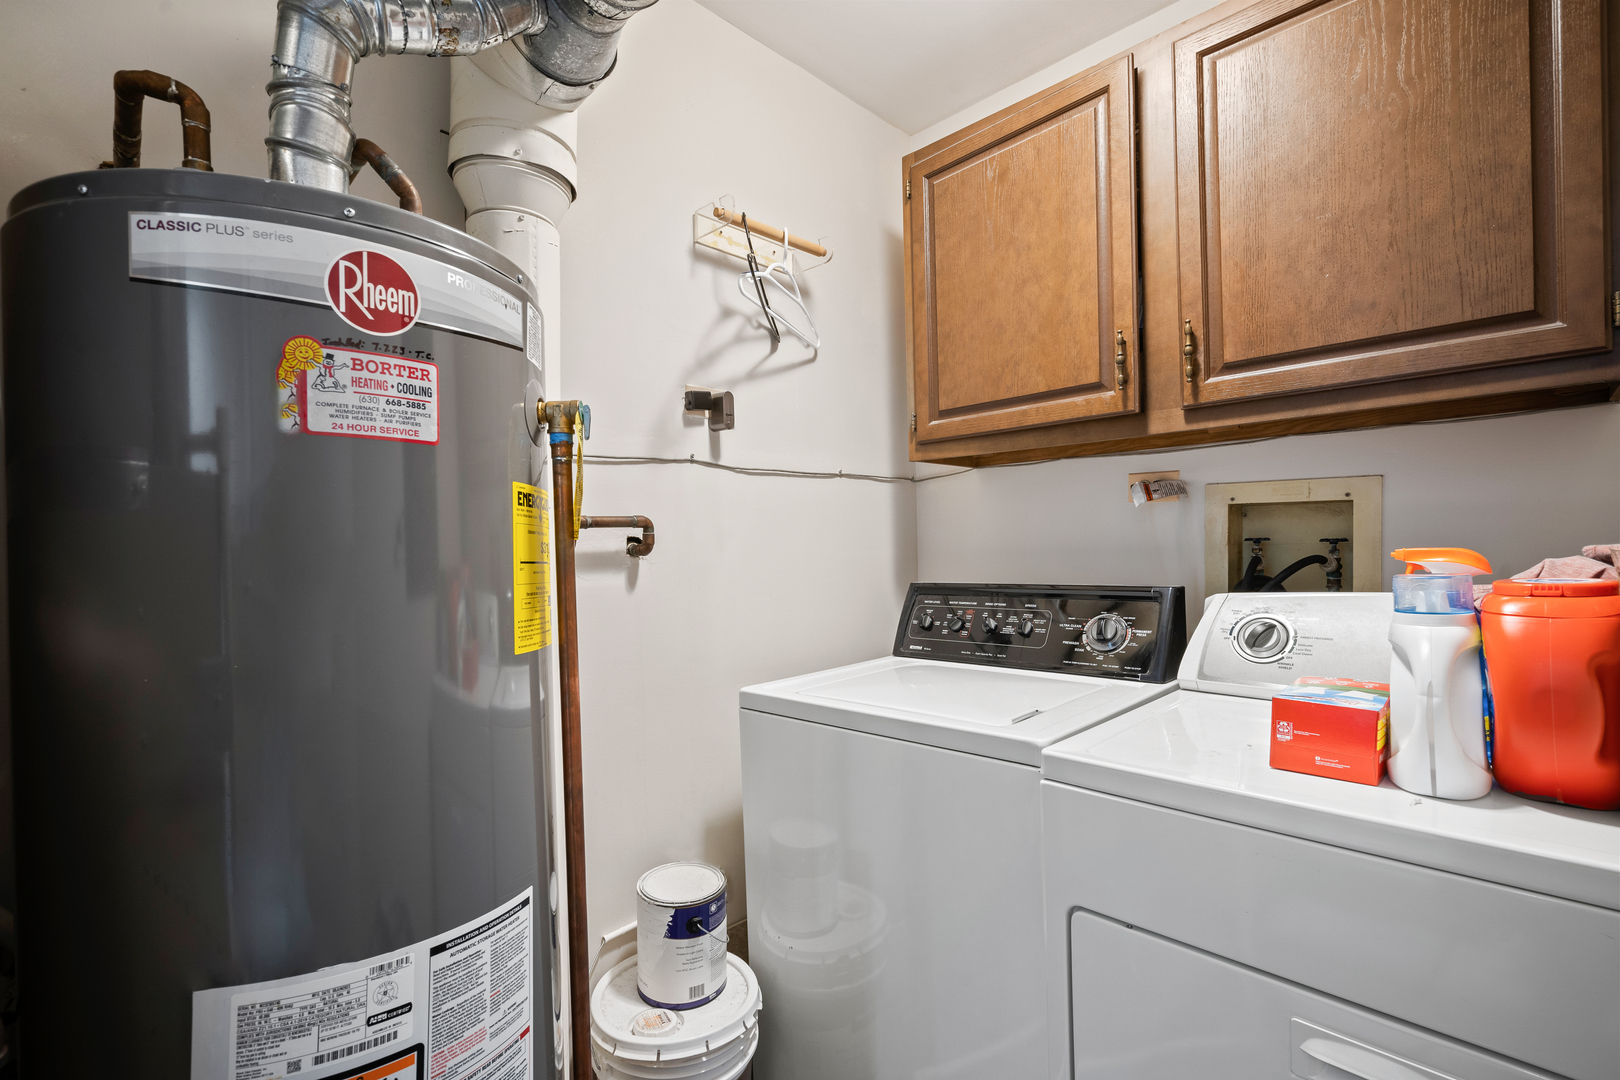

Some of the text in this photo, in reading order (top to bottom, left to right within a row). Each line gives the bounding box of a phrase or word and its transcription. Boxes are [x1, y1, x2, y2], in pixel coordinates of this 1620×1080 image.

[136, 219, 202, 232] CLASSIC
[252, 228, 294, 243] series
[338, 251, 414, 320] Rheem
[447, 272, 521, 316] PROFESSIONAL
[350, 357, 432, 382] BORTER
[351, 376, 432, 398] HEATING COOLING
[315, 401, 349, 409] COMPLETE
[352, 404, 380, 412] FURNACE
[335, 408, 373, 417] HUMIDIFIERS
[358, 395, 426, 410] (630) 668-5885
[331, 422, 420, 437] 24 HOUR SERVICE
[446, 927, 480, 948] INSTALLATION
[478, 924, 489, 934] AND
[489, 910, 509, 928] OPERATION
[449, 940, 476, 958] AUTOMATIC
[477, 930, 496, 945] STORAGE
